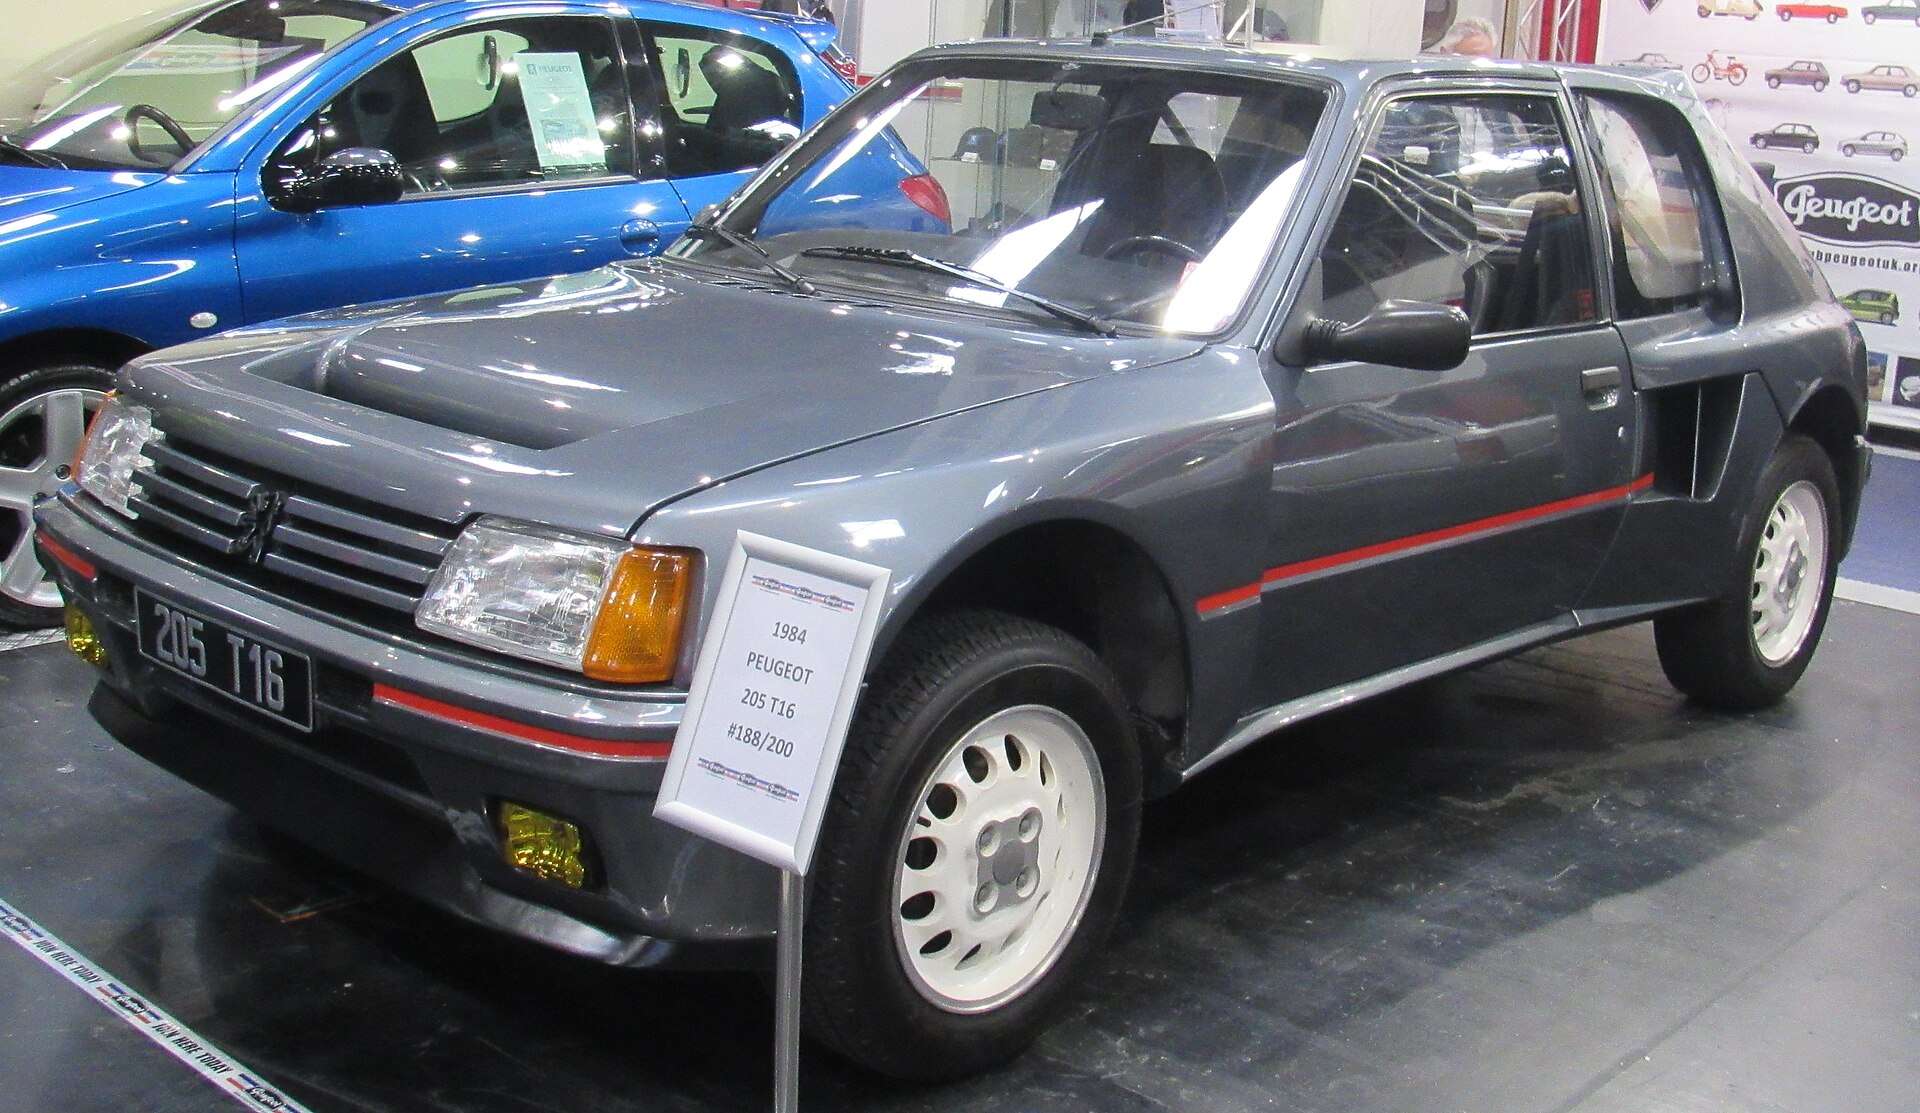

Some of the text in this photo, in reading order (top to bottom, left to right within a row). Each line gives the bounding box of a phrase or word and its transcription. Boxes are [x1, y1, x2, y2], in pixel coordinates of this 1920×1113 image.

[1783, 184, 1913, 232] Peugeot
[772, 621, 807, 645] 1984
[155, 603, 284, 711] 205 T16
[746, 651, 814, 685] PEUGEOT
[741, 688, 796, 719] 205 T16
[727, 722, 794, 758] #188/200
[50, 951, 79, 967] HERE
[70, 964, 104, 984] TODAY
[152, 1022, 234, 1074] JOIN HERE TODAY
